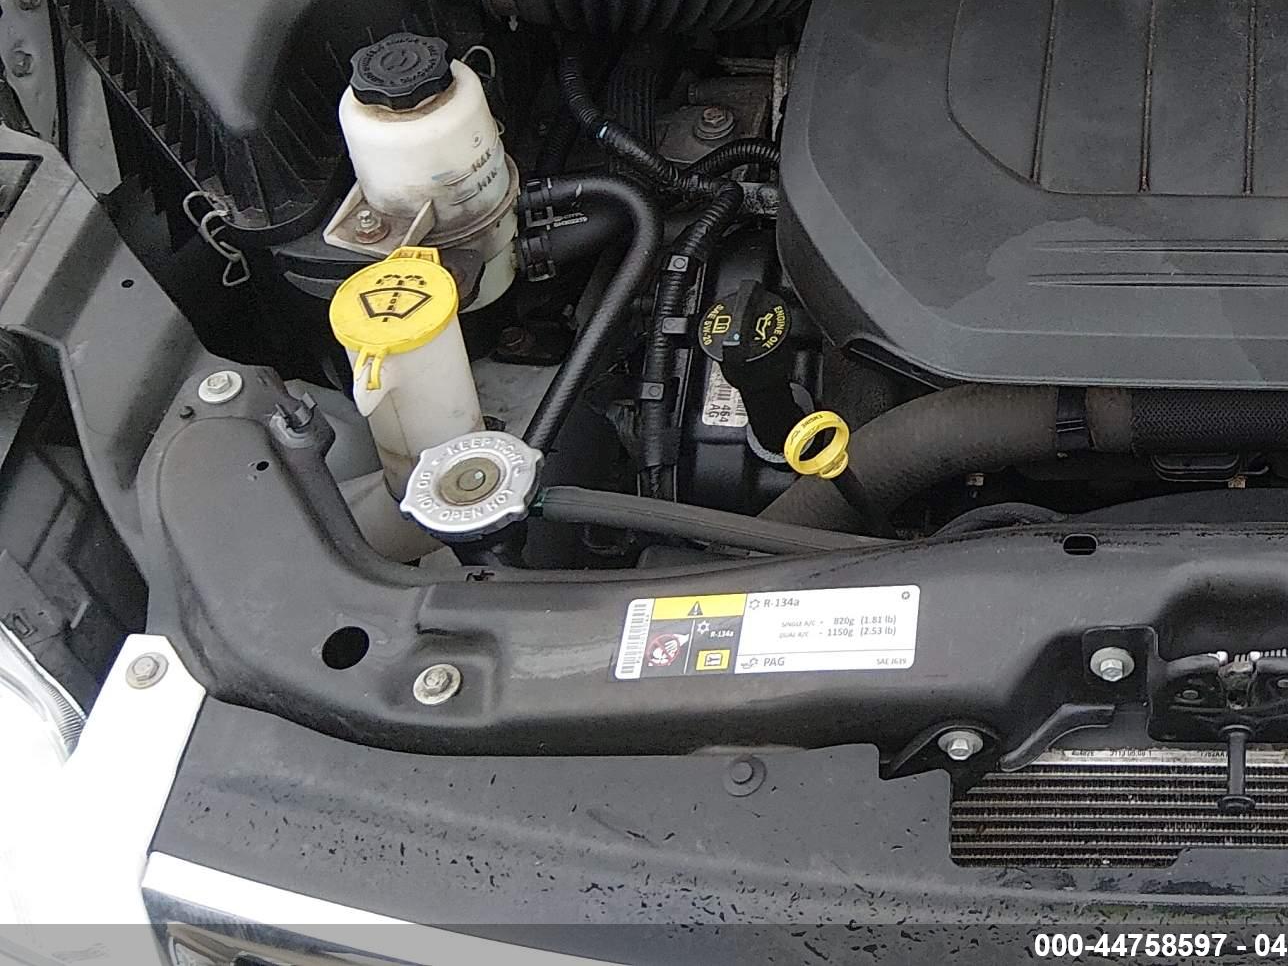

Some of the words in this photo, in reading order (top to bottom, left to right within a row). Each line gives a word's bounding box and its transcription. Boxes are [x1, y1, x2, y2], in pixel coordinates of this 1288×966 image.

[472, 148, 491, 172] MAX
[709, 303, 725, 320] SAE
[773, 305, 786, 335] ENGINE
[702, 320, 714, 346] 5W-20
[762, 334, 779, 349] OIL
[719, 404, 732, 423] 464
[446, 437, 492, 456] KEEP
[418, 471, 431, 488] DO
[415, 493, 441, 513] NOT
[485, 488, 515, 512] HOT
[439, 507, 485, 522] OPEN
[763, 596, 800, 608] R-134a
[803, 619, 817, 628] A/C
[833, 616, 855, 627] 820g
[860, 615, 883, 626] (1.81
[884, 614, 897, 625] lb)
[710, 630, 735, 638] R-134a
[827, 627, 855, 638] 1150g
[860, 626, 883, 637] (2.53
[884, 625, 897, 636] lb)
[763, 656, 786, 667] PAG
[876, 657, 889, 666] SAE
